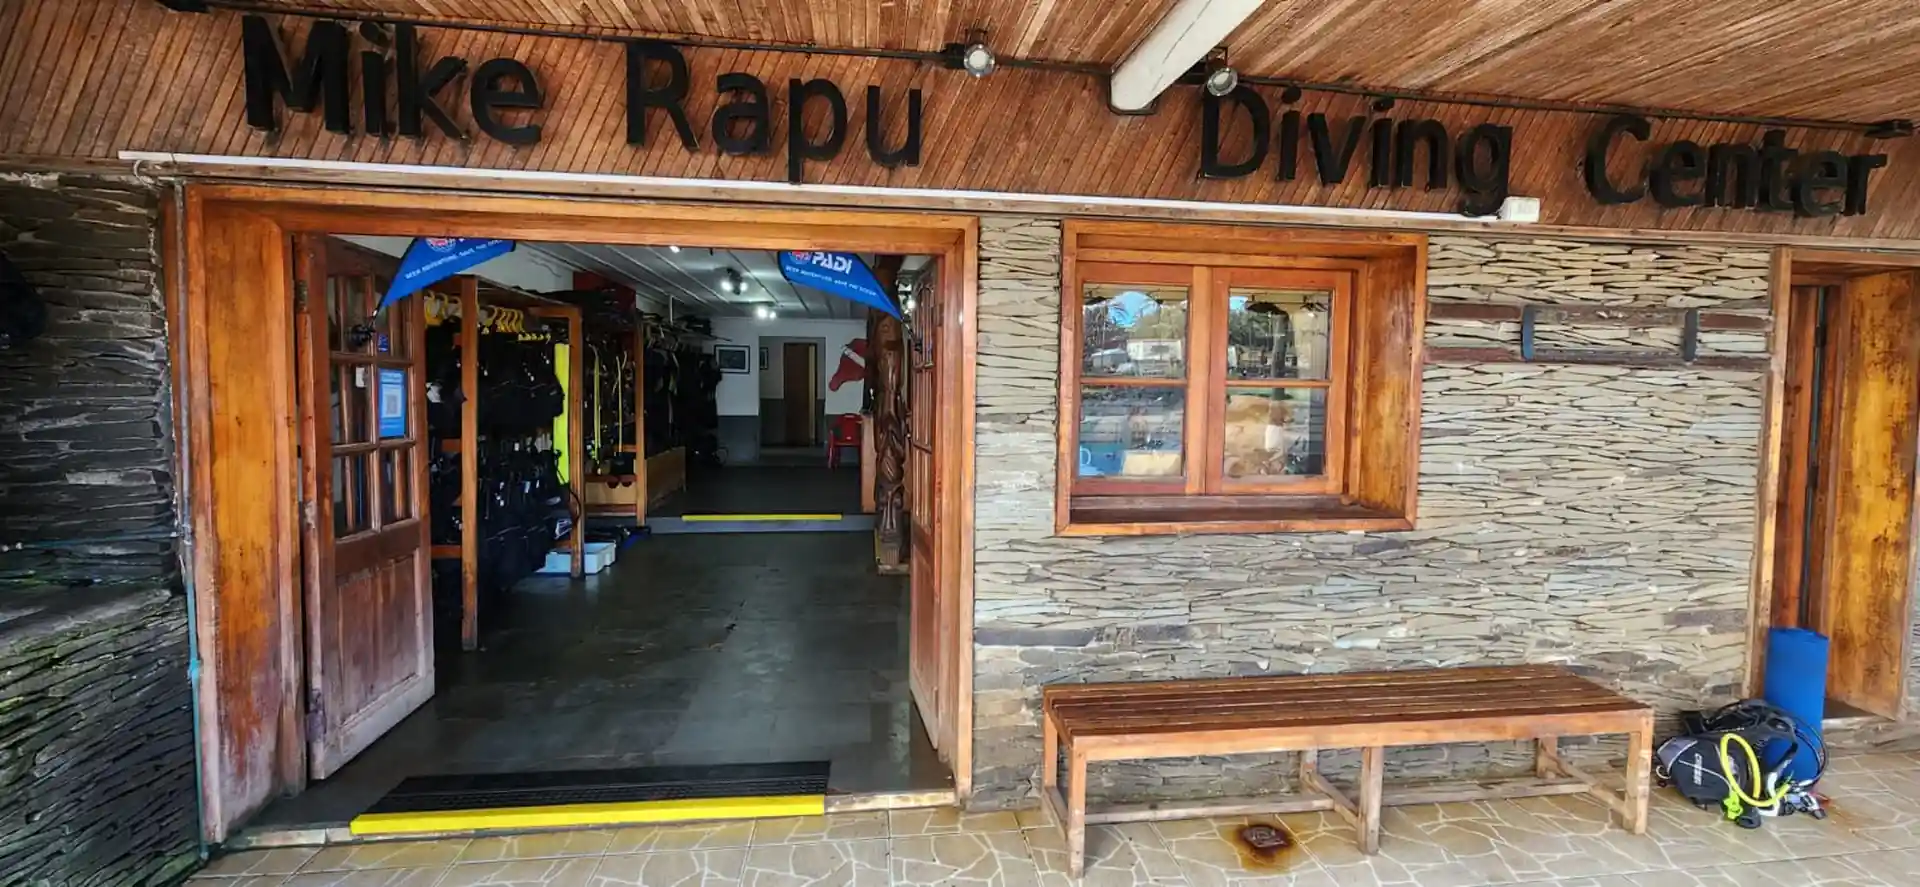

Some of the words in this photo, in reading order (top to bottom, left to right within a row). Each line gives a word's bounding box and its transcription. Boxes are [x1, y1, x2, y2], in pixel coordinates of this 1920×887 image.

[242, 15, 542, 145] Mike
[626, 41, 922, 184] Rapu
[1202, 84, 1513, 217] Diving
[1582, 114, 1887, 222] Center
[811, 251, 853, 275] PADI
